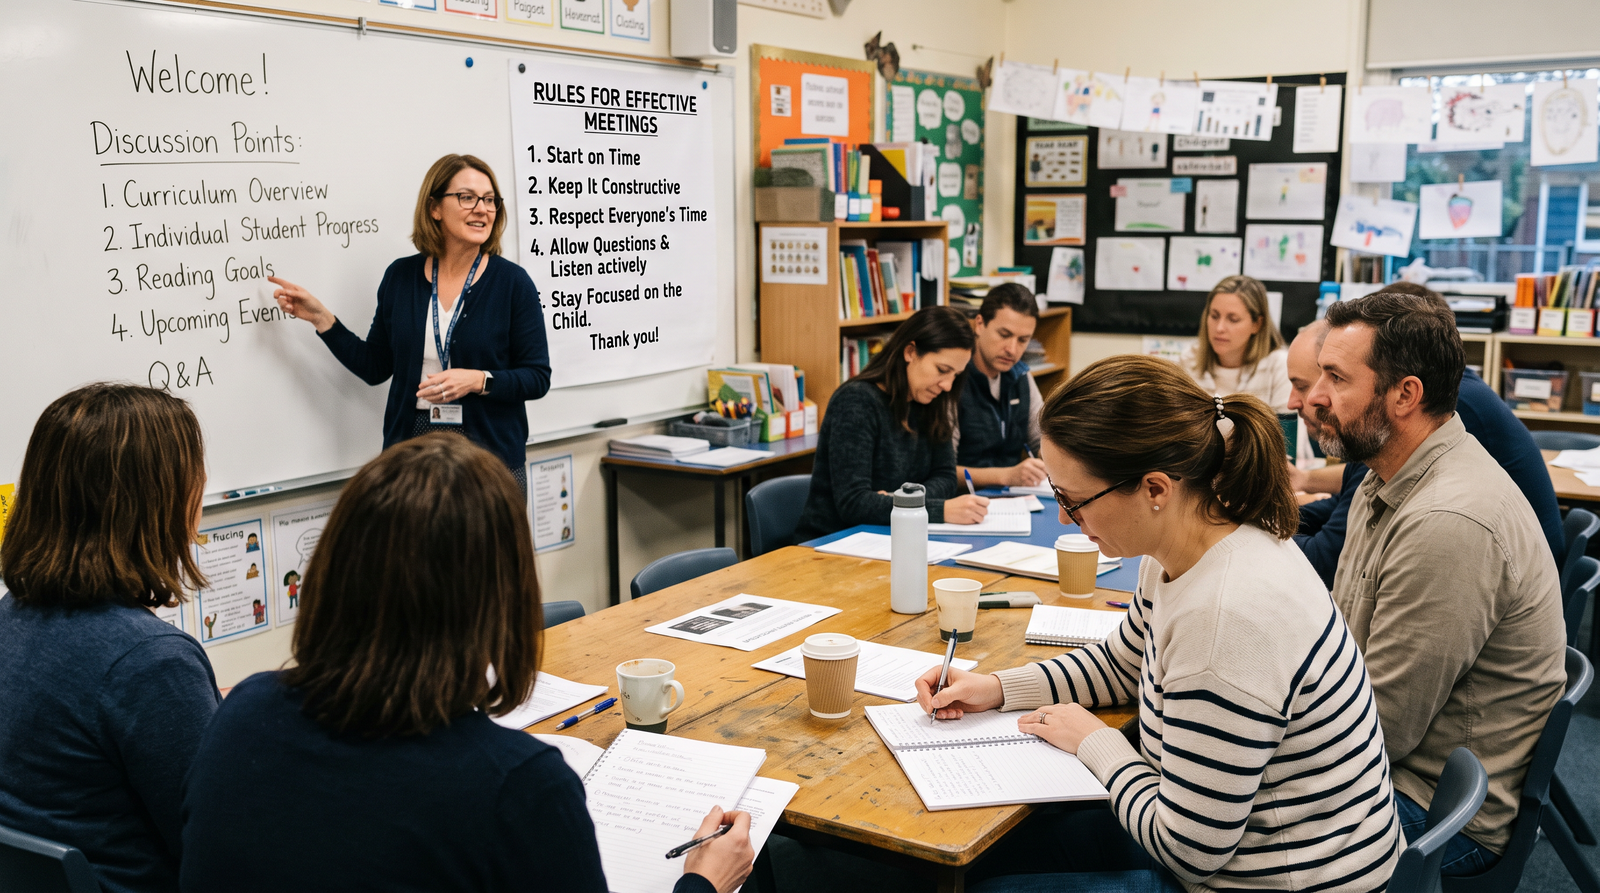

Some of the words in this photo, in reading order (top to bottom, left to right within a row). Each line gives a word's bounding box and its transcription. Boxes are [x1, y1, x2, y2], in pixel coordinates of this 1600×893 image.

[126, 50, 269, 96] Welcome!
[533, 82, 586, 104] RULES
[592, 87, 621, 106] FOR
[625, 90, 697, 112] EFFECTIVE
[584, 112, 658, 134] MEETINGS
[90, 120, 219, 156] Discussion
[231, 120, 302, 154] Points:
[527, 145, 542, 163] 1.
[547, 146, 584, 164] Start
[587, 152, 605, 165] on
[609, 148, 641, 166] Time
[102, 183, 115, 208] 1.
[123, 179, 237, 209] Curriculum
[248, 177, 329, 203] Overview
[528, 176, 543, 195] 2.
[548, 177, 583, 199] Keep
[588, 177, 598, 195] It
[601, 178, 681, 195] Constructive
[103, 225, 123, 252] 2.
[129, 219, 229, 250] Individual
[240, 216, 307, 242] Student
[315, 211, 380, 249] Progress
[529, 207, 544, 226] 3.
[549, 207, 605, 229] Respect
[608, 206, 676, 228] Everyone's
[679, 206, 708, 222] Time
[530, 238, 545, 256] 4.
[549, 237, 589, 256] Allow
[593, 235, 656, 257] Questions
[660, 234, 670, 250] &
[107, 267, 128, 295] 3.
[136, 263, 216, 301] Reading
[224, 256, 275, 283] Goals
[550, 260, 593, 278] Listen
[597, 256, 647, 277] actively
[551, 291, 582, 311] Stay
[587, 284, 640, 305] Focused
[644, 287, 659, 300] on
[663, 282, 682, 298] the
[111, 313, 133, 342] 4.
[140, 306, 230, 346] Upcoming
[552, 310, 592, 330] Child.
[589, 330, 630, 350] Thank
[633, 326, 659, 349] you!
[148, 356, 214, 393] Q&A
